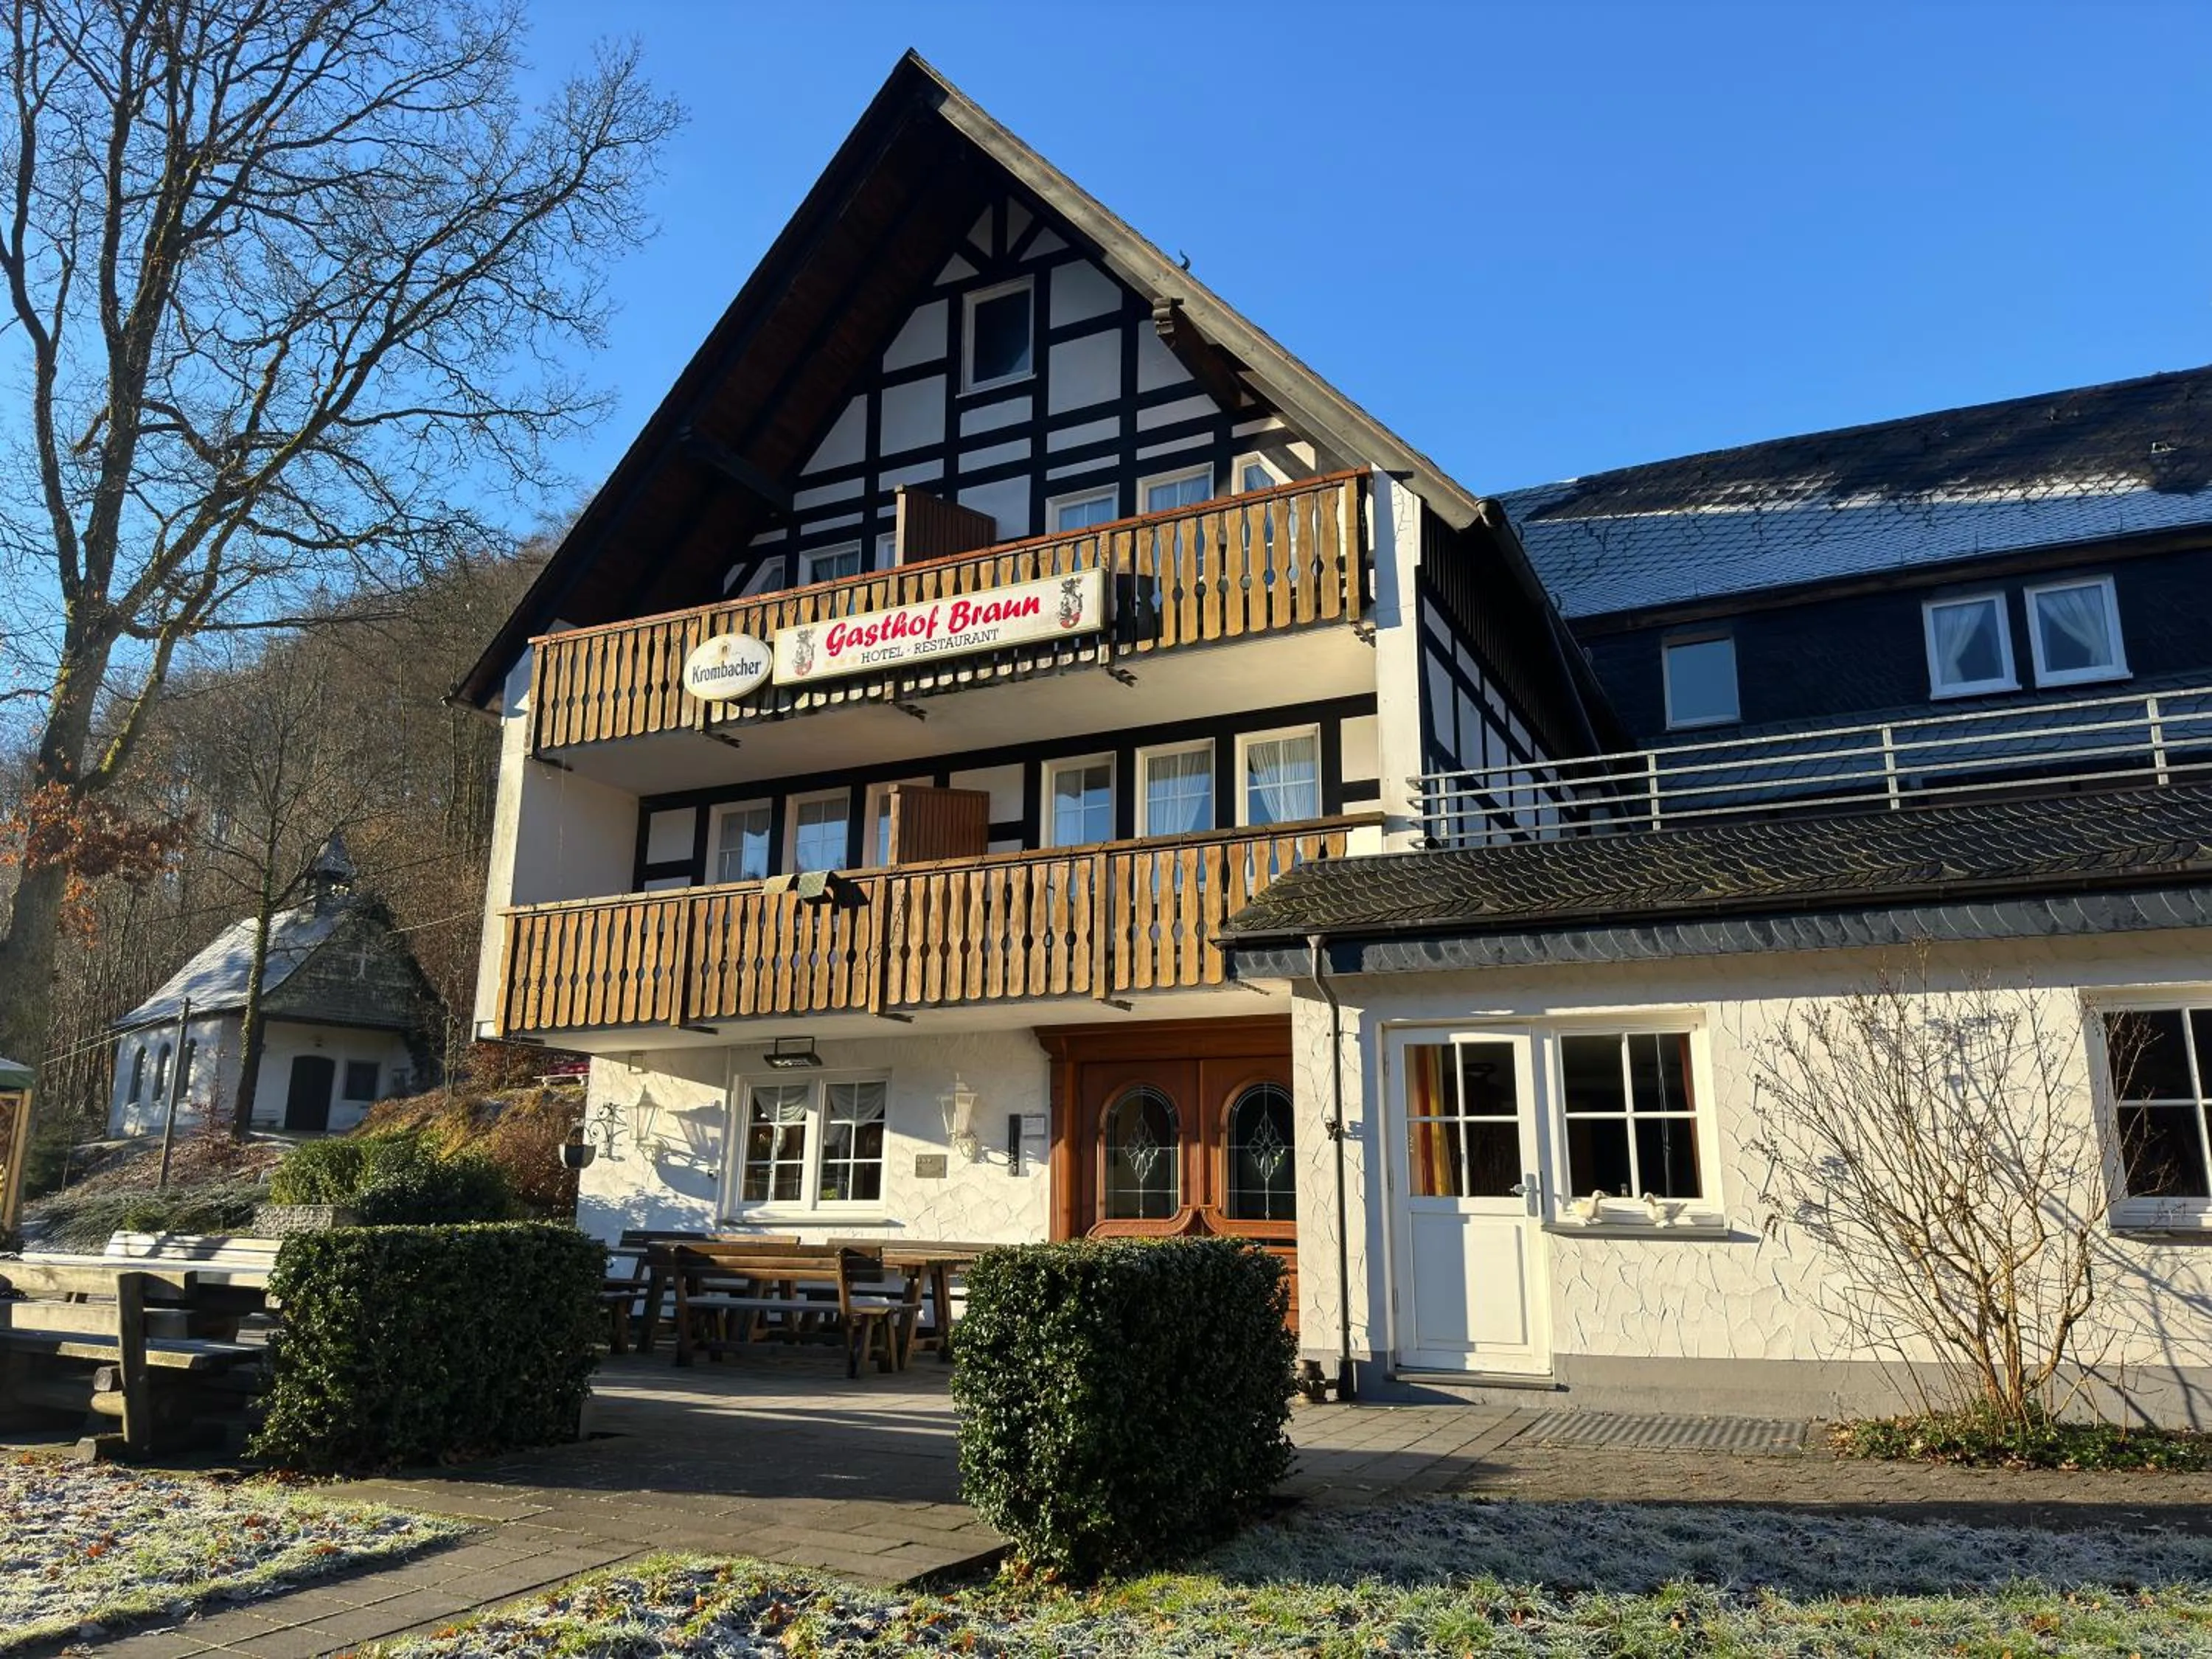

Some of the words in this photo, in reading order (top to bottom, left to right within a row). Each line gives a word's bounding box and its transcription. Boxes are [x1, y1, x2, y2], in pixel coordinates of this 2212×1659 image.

[825, 604, 939, 657] Gasthof
[948, 596, 1040, 635] Braun
[860, 646, 904, 664] HOTEL
[914, 628, 1000, 655] RESTAURANT
[692, 657, 762, 684] Krombacher
